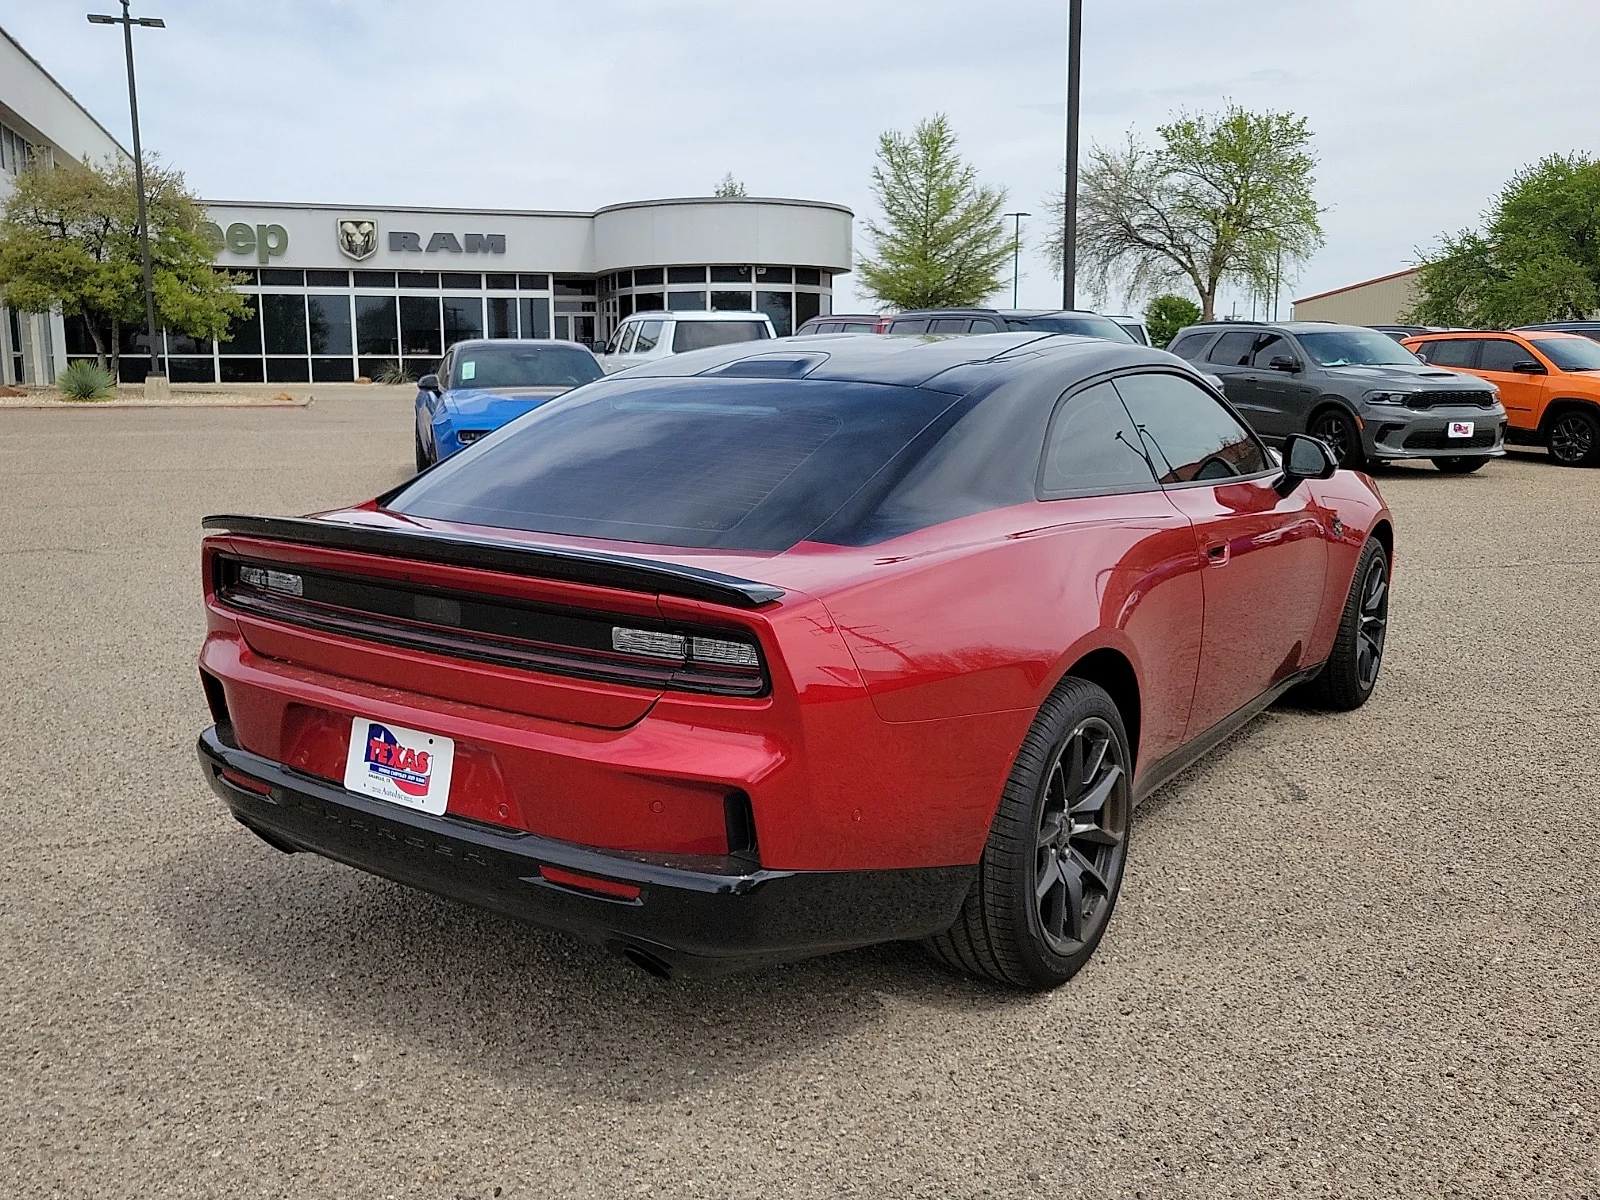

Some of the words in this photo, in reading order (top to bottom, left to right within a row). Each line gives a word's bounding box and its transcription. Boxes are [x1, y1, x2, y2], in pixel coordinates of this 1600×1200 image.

[196, 222, 289, 263] eep
[388, 231, 506, 253] RAM
[369, 739, 430, 774] TEXAS
[299, 802, 488, 866] CHARGER
